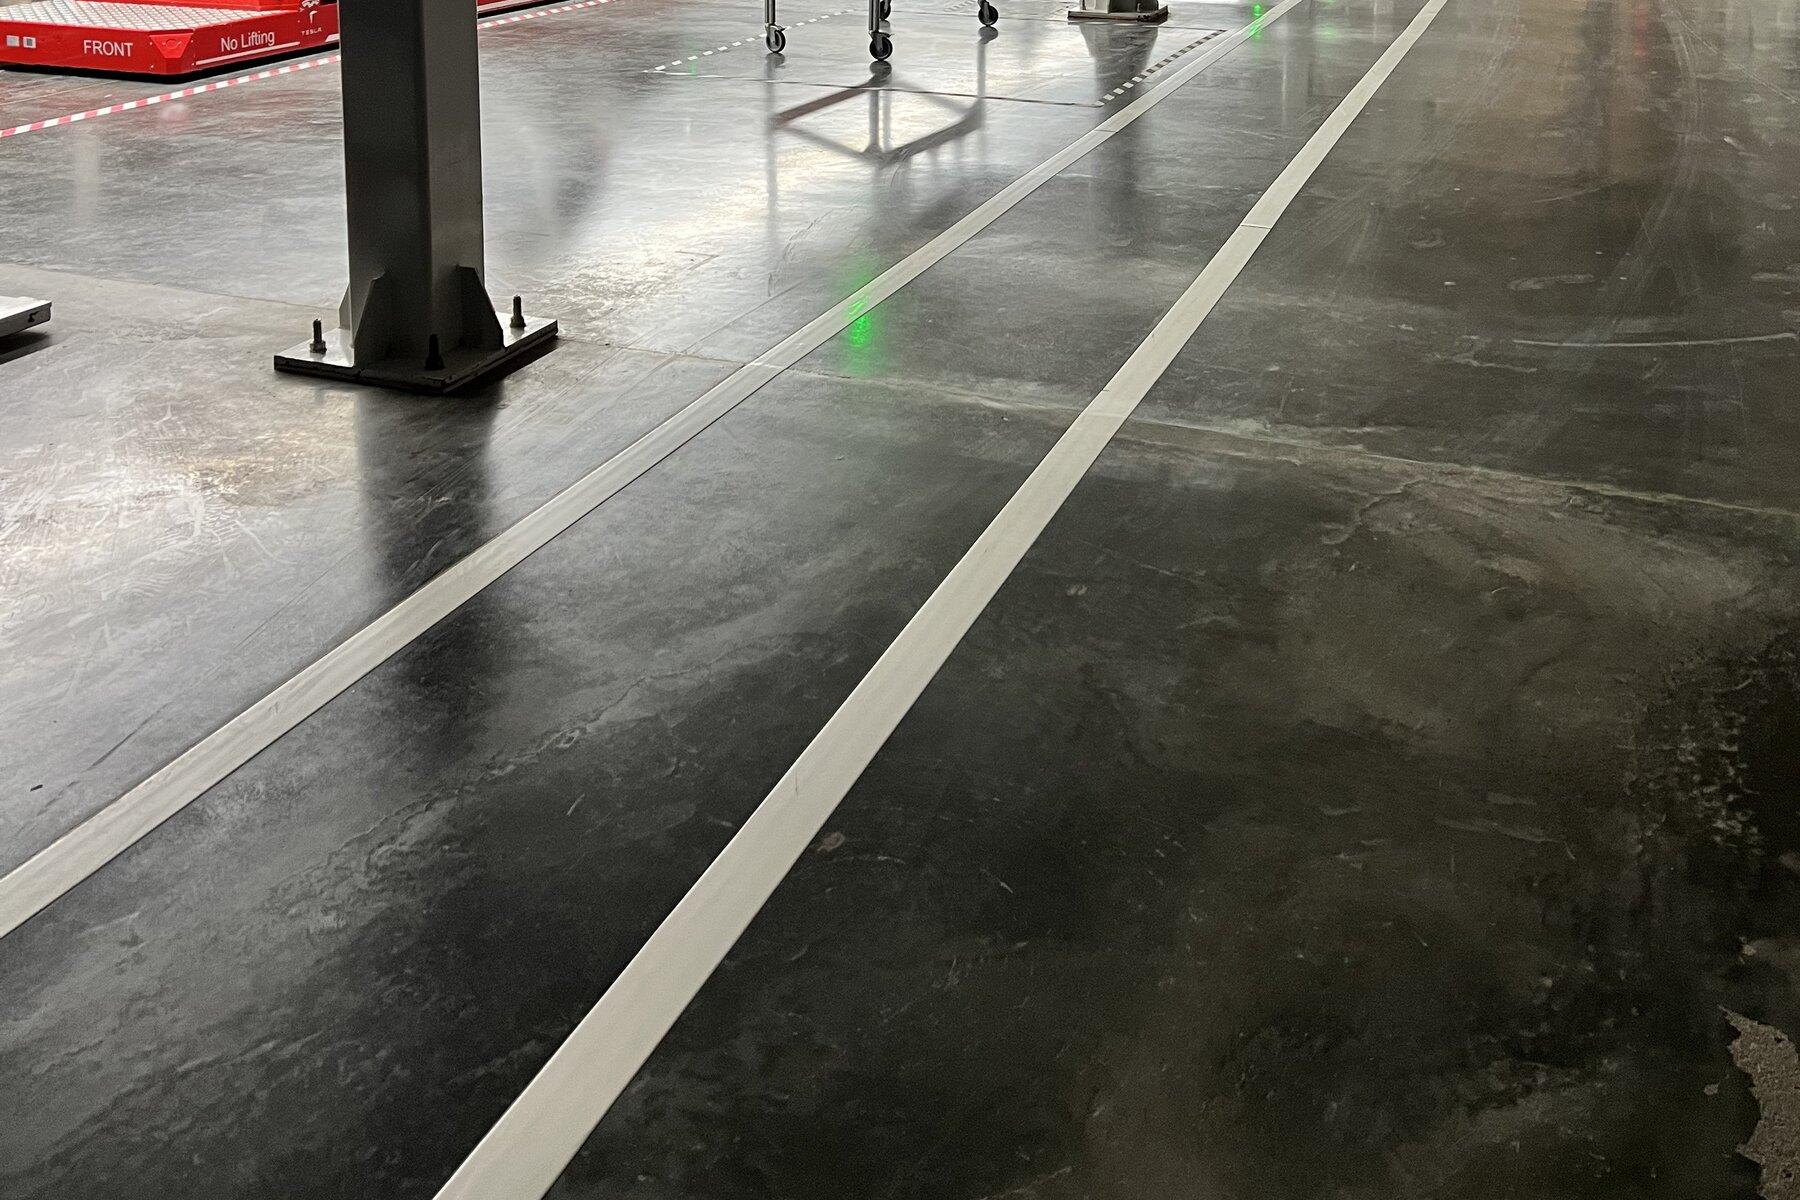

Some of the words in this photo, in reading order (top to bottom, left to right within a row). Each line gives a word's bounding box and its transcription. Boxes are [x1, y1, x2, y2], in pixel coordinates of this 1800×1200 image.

[301, 27, 322, 36] TESLA
[83, 39, 134, 57] FRONT
[220, 37, 239, 52] No
[241, 31, 275, 49] Lifting
